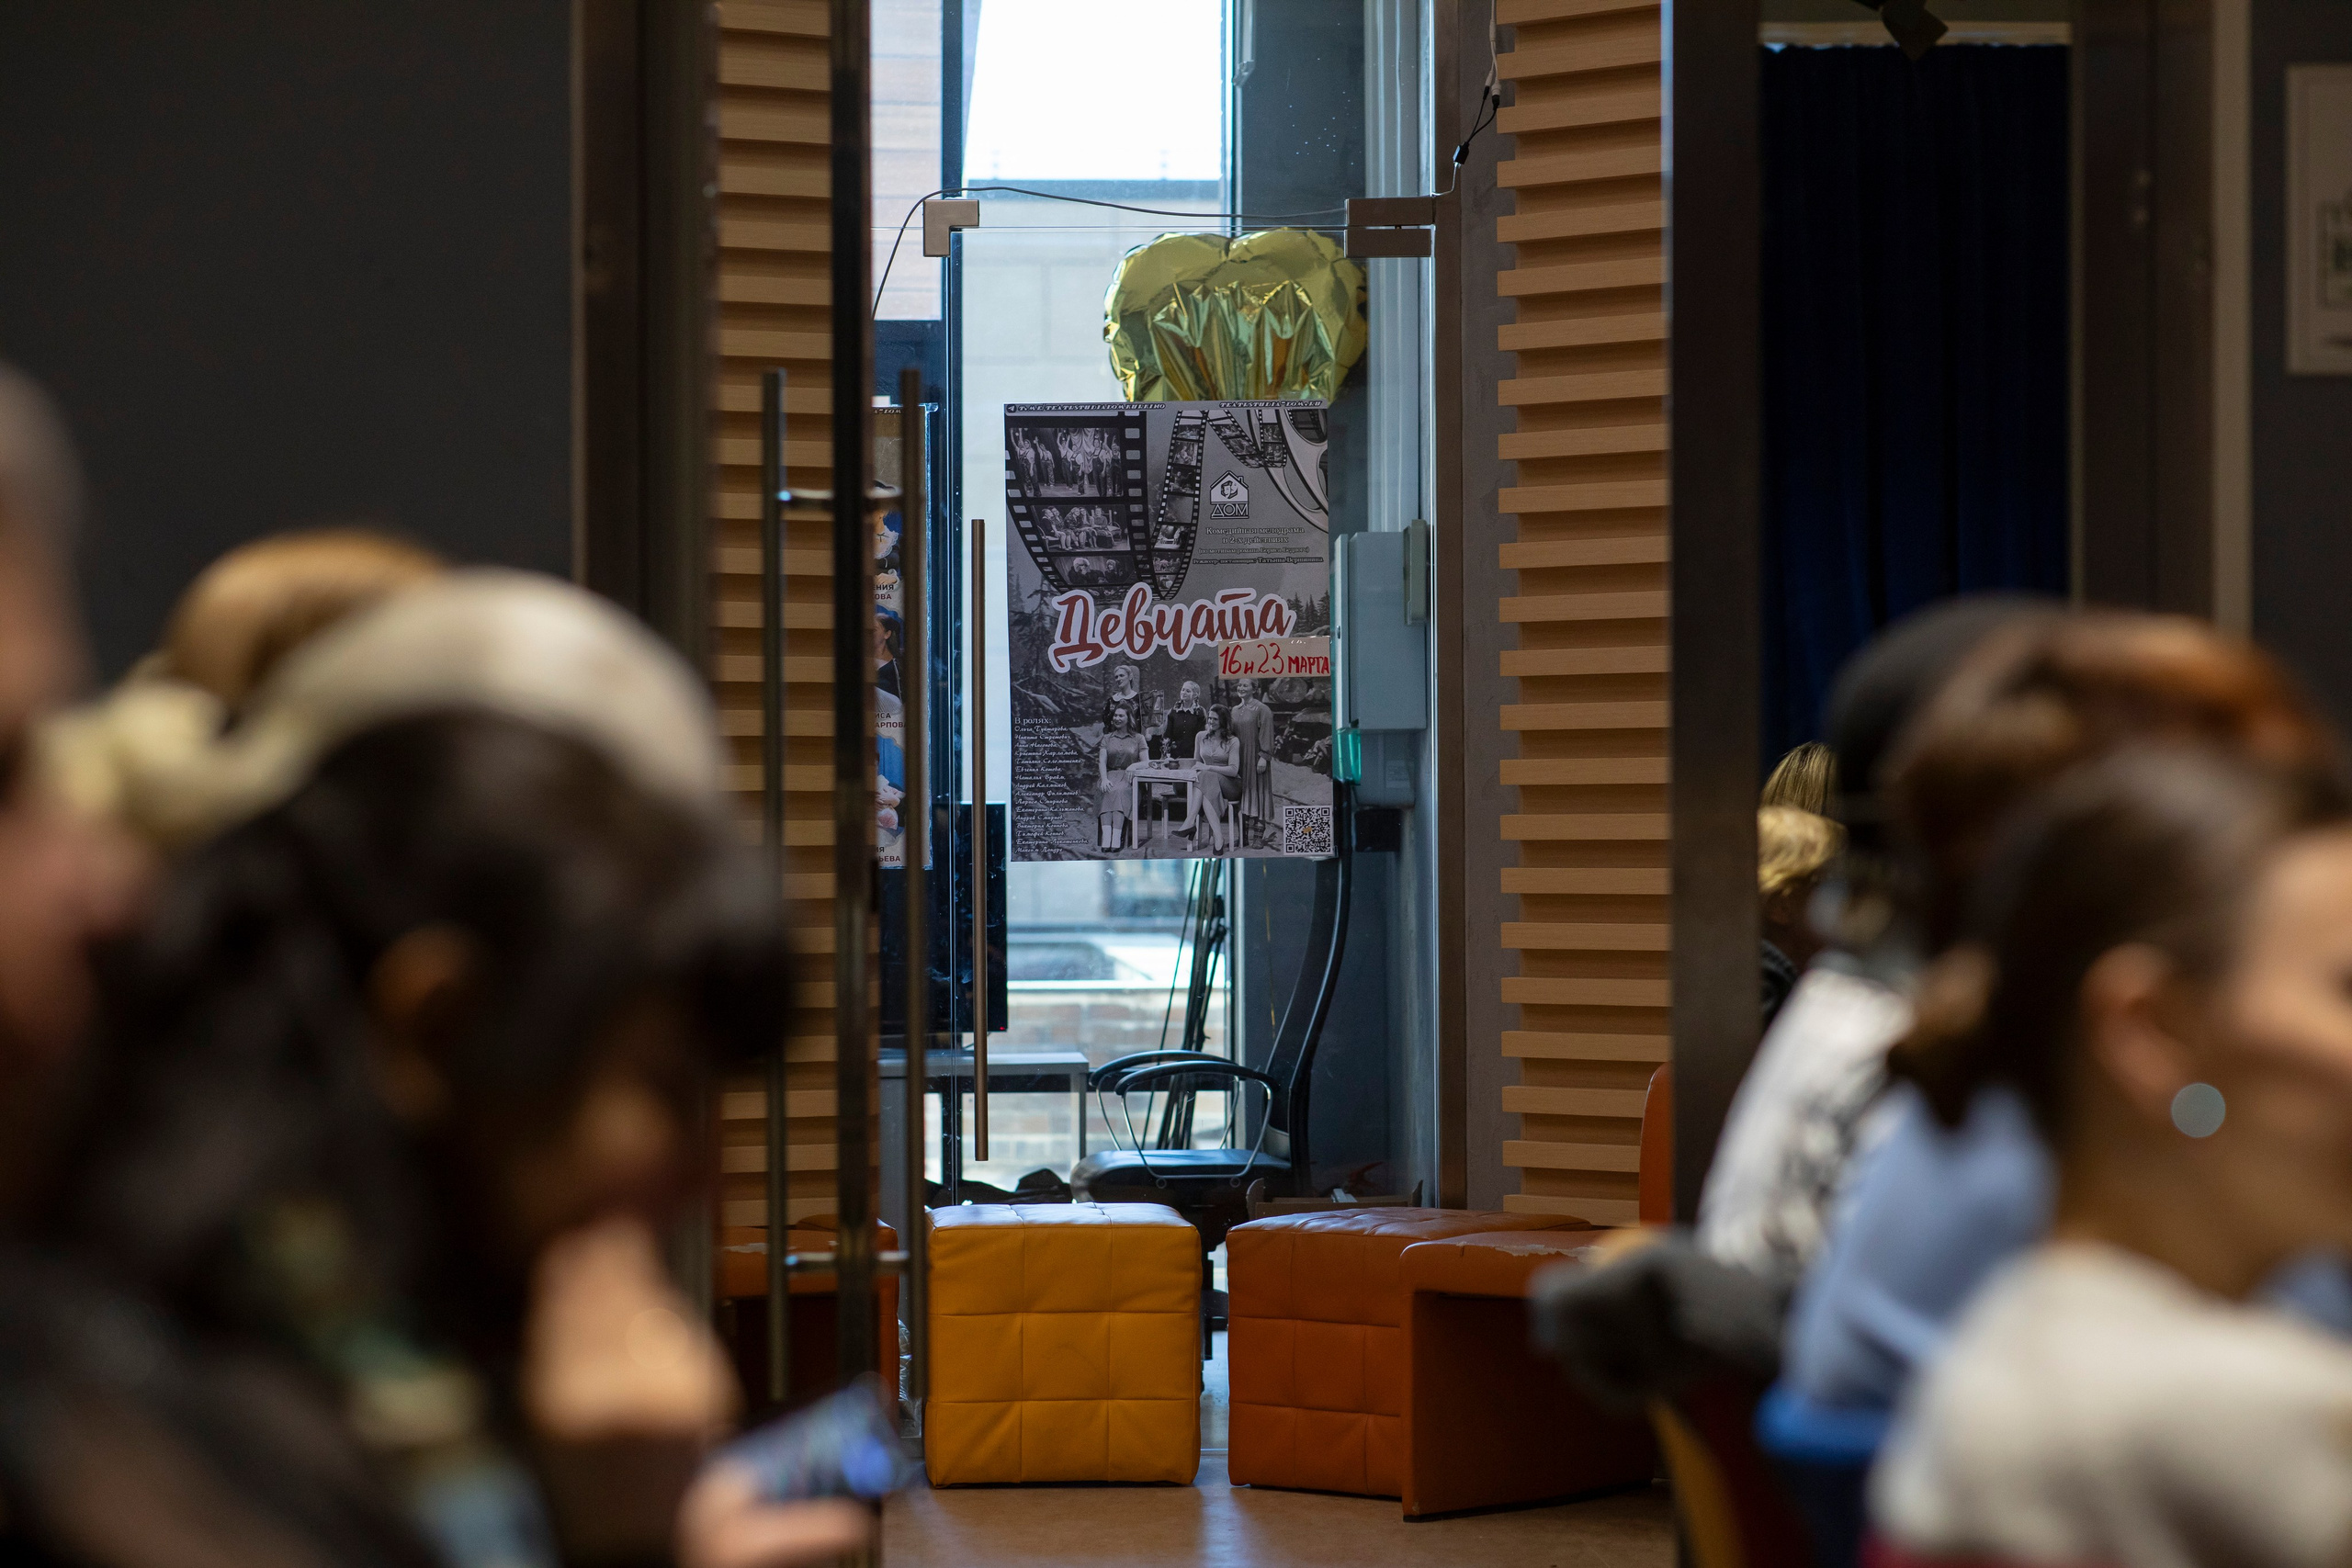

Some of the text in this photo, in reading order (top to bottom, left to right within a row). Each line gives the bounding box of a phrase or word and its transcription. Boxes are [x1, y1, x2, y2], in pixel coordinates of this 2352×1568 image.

[1211, 503, 1249, 517] ДОМ
[1245, 536, 1289, 545] действиях
[1050, 584, 1295, 670] Девчата
[1218, 643, 1242, 675] 16
[1256, 642, 1284, 675] 23
[1023, 717, 1052, 726] ролях:
